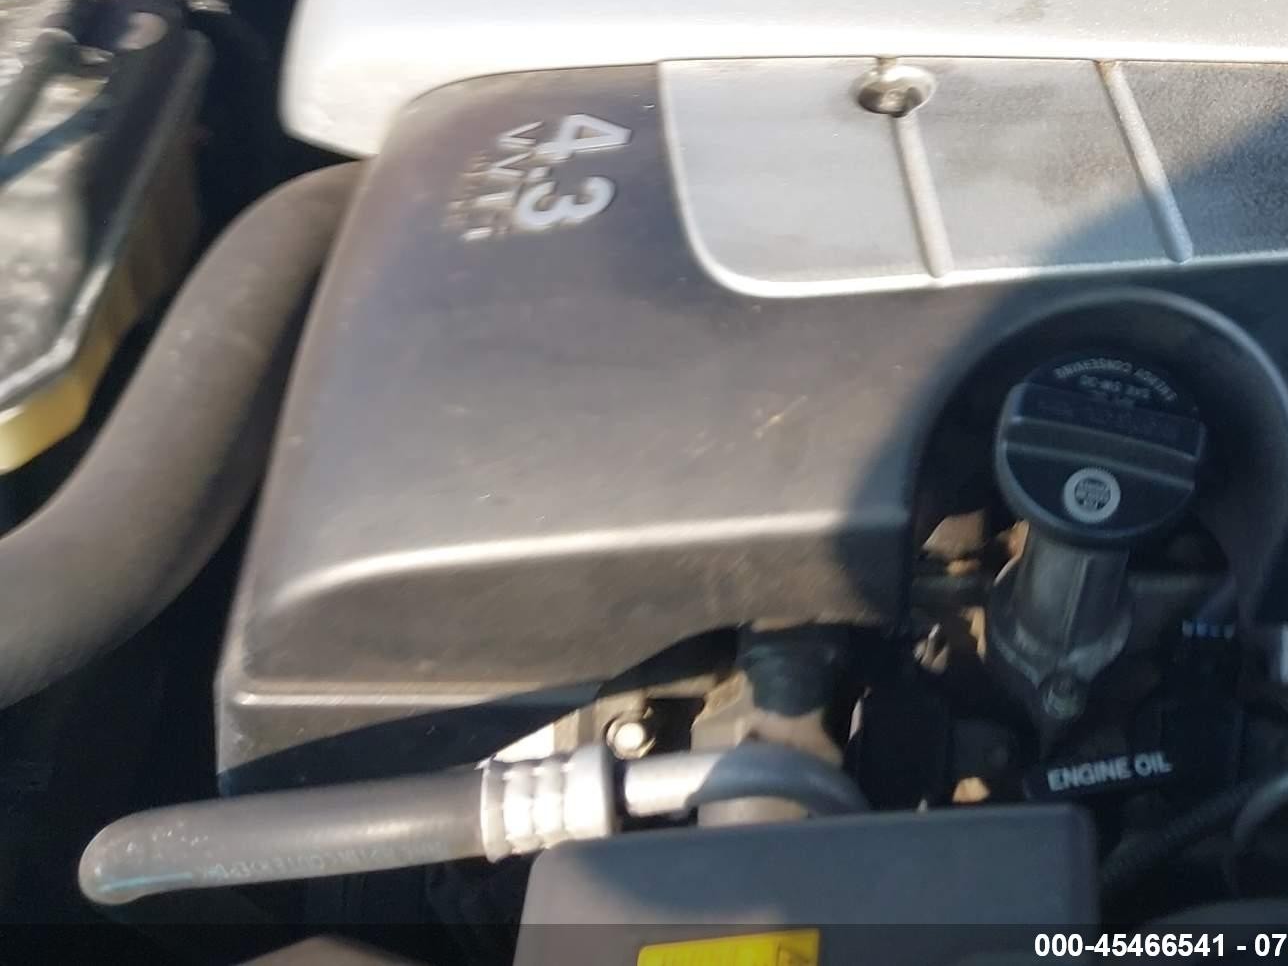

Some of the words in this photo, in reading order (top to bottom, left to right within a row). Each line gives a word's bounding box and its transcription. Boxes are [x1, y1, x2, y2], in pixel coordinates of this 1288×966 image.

[518, 113, 632, 230] 4.3
[1047, 756, 1132, 791] ENGINE
[1134, 752, 1172, 776] OIL
